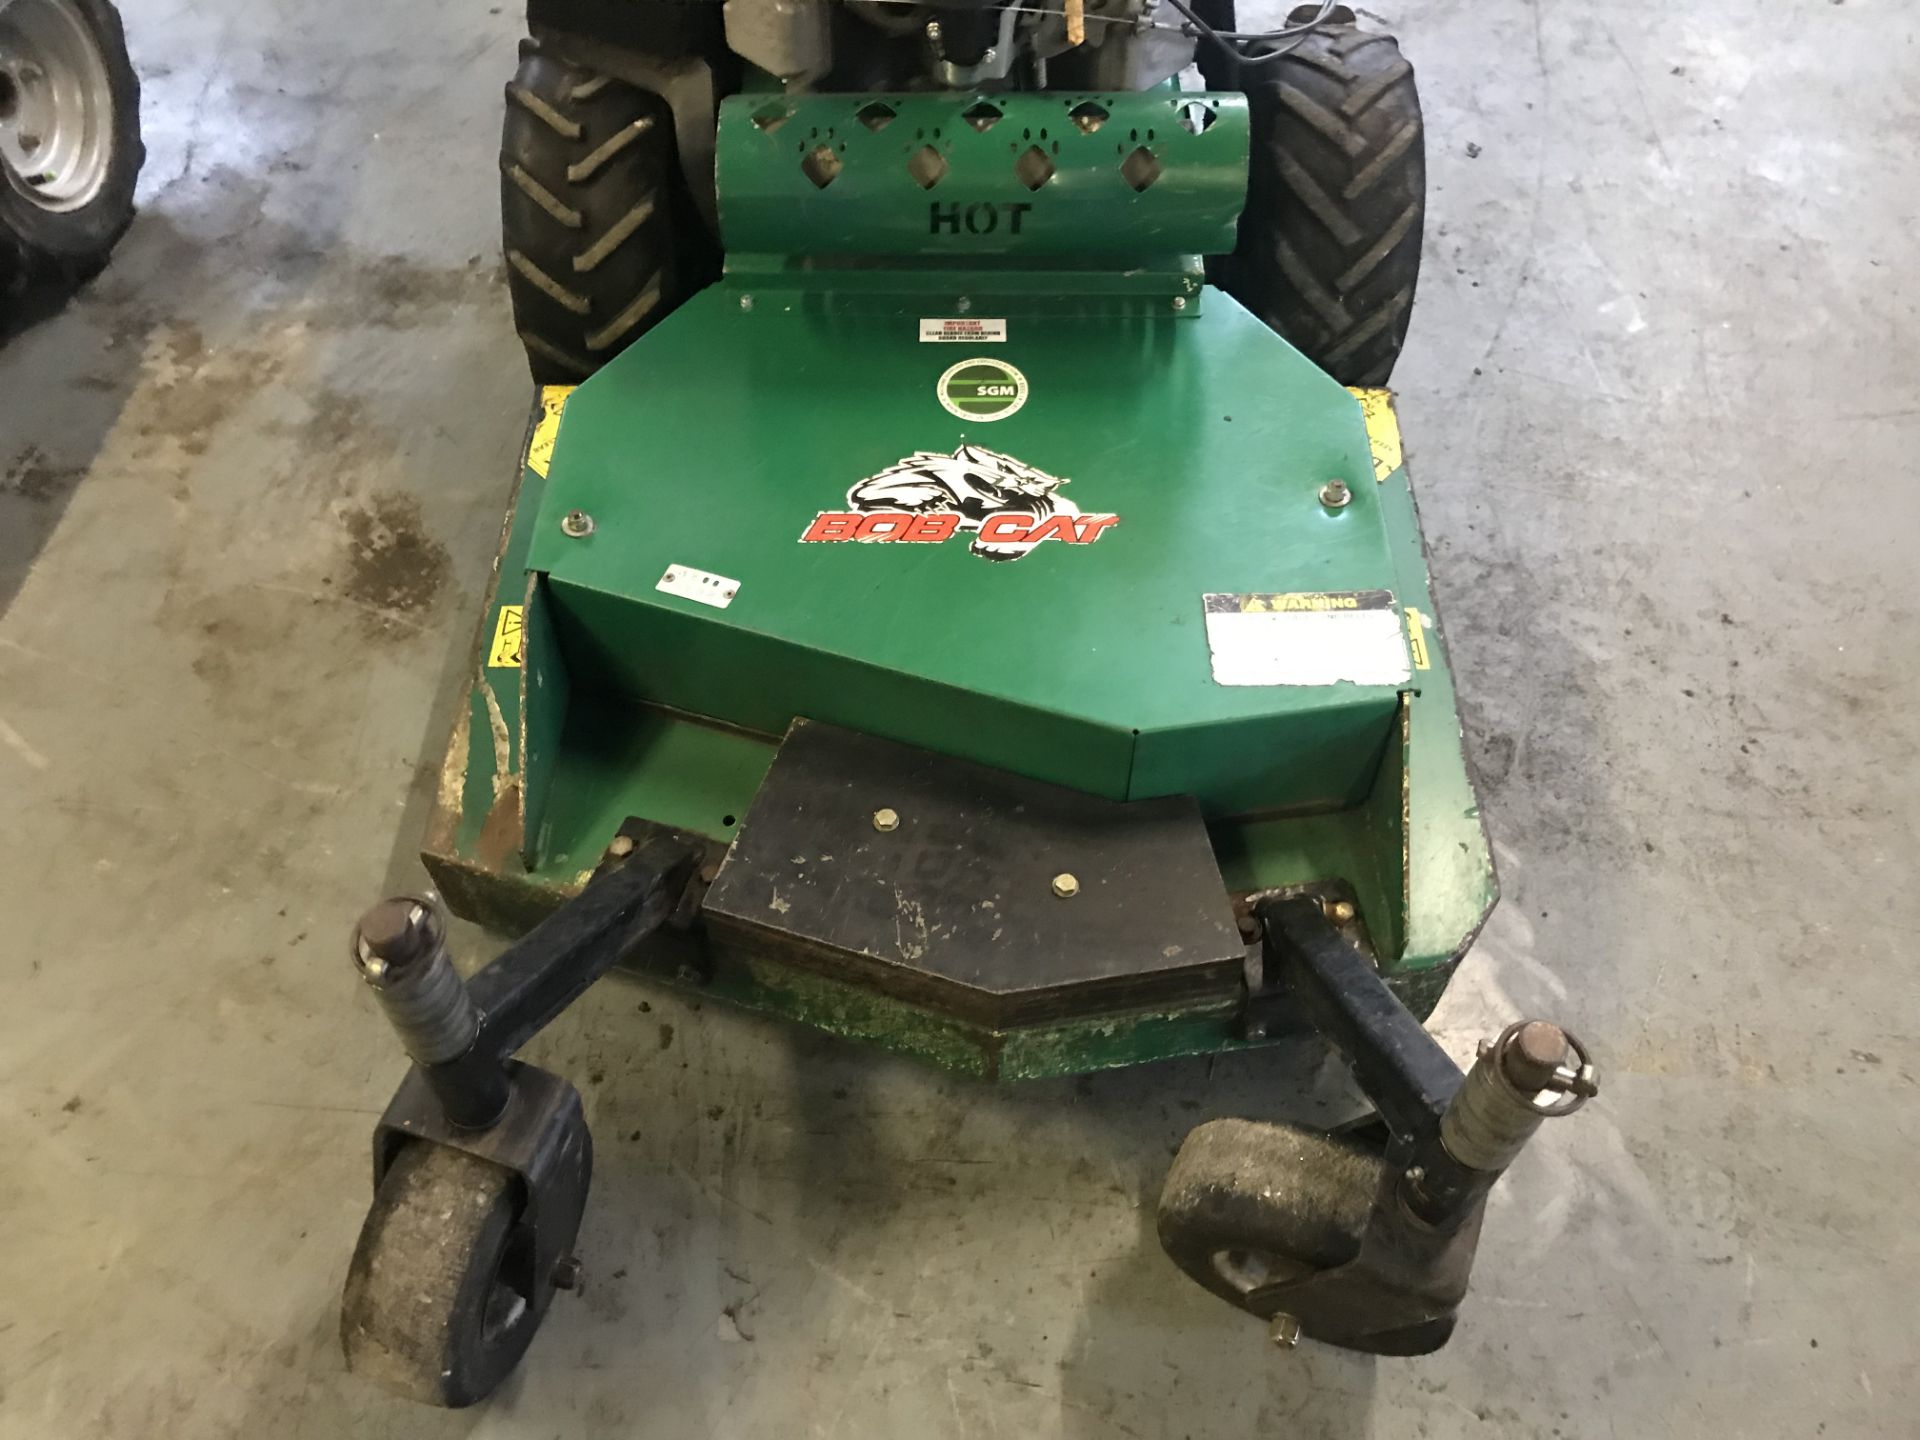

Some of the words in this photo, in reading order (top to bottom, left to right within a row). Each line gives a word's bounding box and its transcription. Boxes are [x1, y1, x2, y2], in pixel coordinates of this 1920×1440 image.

[930, 201, 1032, 235] HOT
[977, 385, 1015, 396] SGM
[1270, 597, 1358, 611] WARNING
